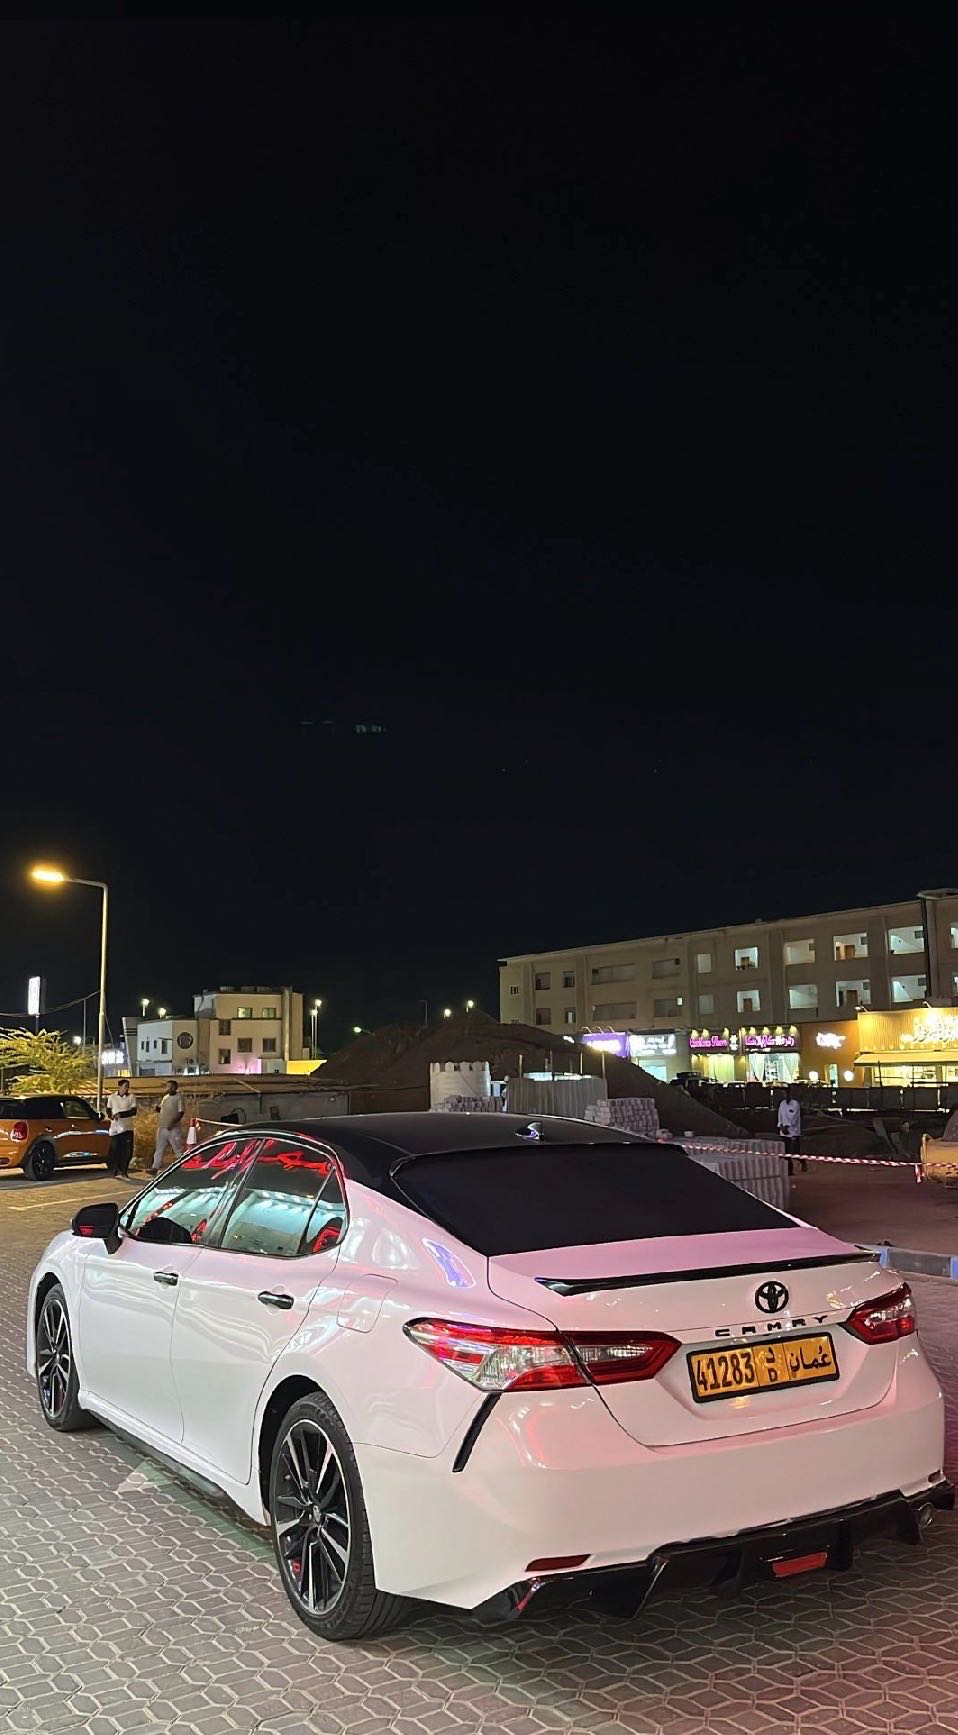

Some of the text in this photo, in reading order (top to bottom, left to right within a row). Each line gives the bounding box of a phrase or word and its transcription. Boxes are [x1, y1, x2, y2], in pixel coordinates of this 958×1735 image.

[715, 1315, 828, 1336] CAMRY
[697, 1352, 756, 1391] 41283
[767, 1368, 778, 1382] D
